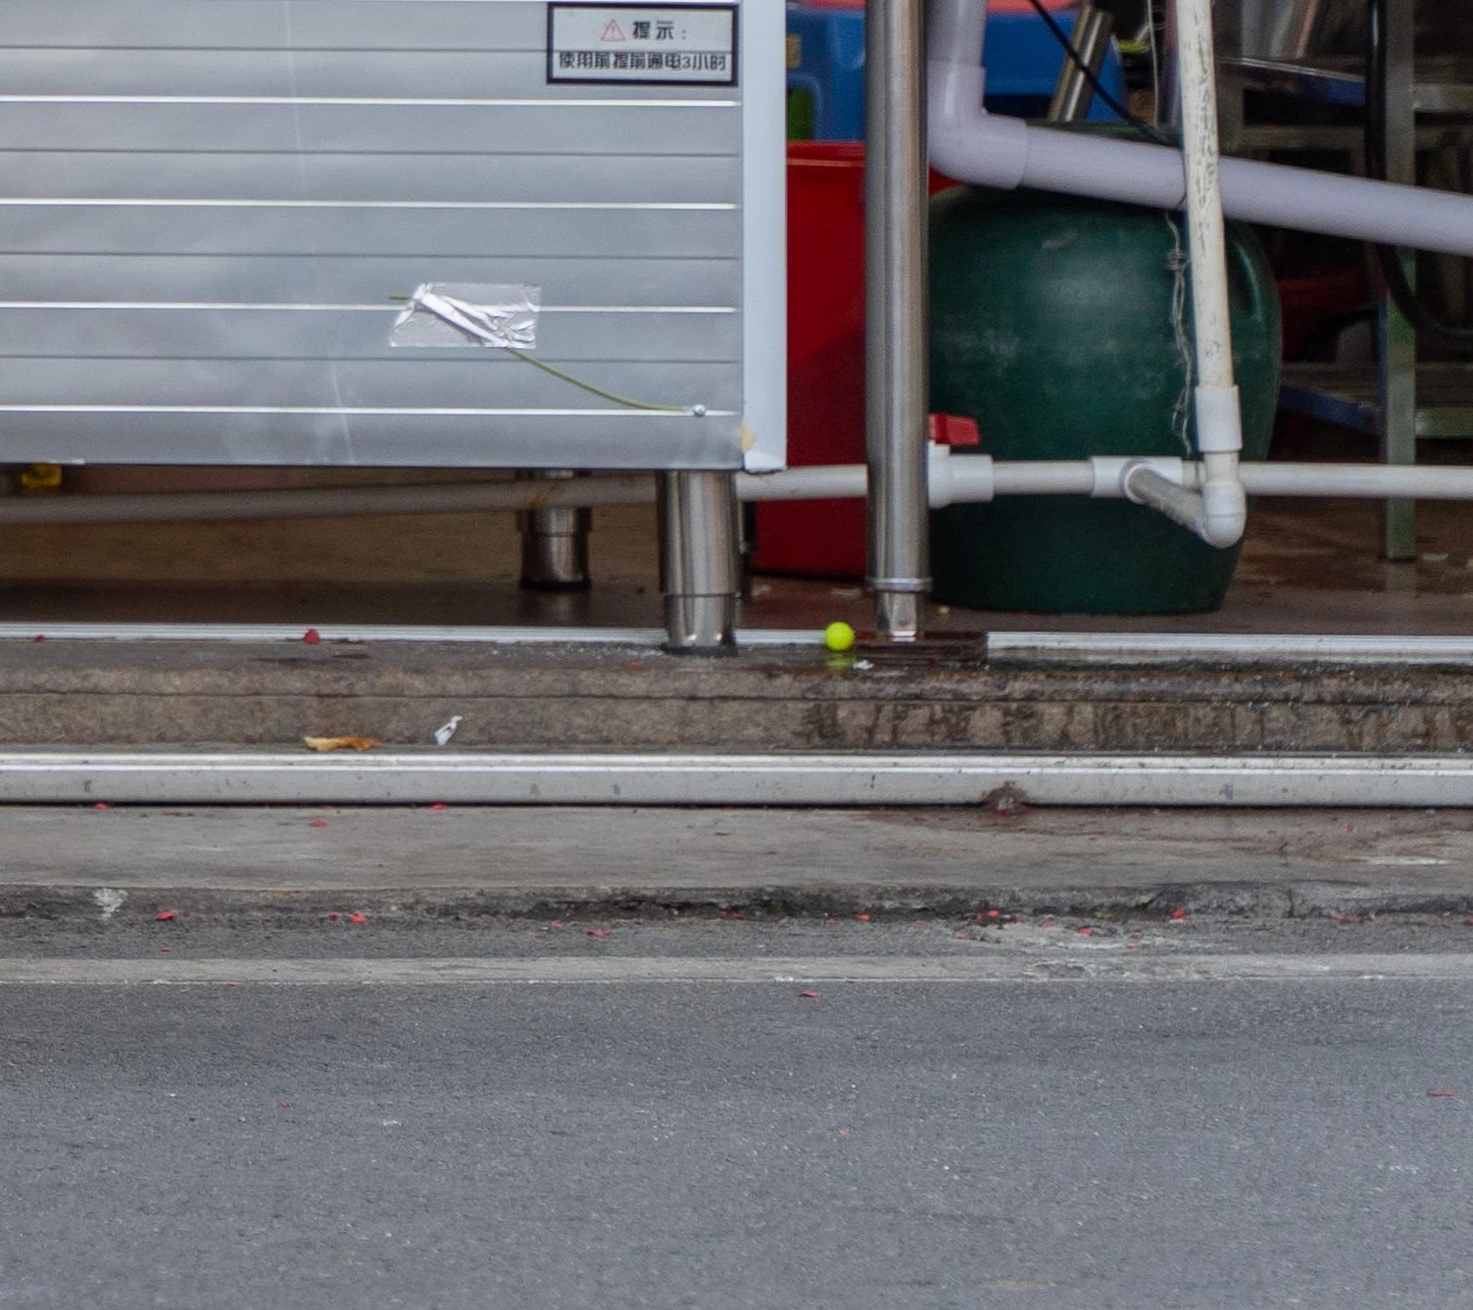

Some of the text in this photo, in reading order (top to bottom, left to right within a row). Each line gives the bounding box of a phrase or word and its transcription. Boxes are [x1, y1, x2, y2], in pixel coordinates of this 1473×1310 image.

[558, 50, 727, 72] 使用前提前通电3小时
